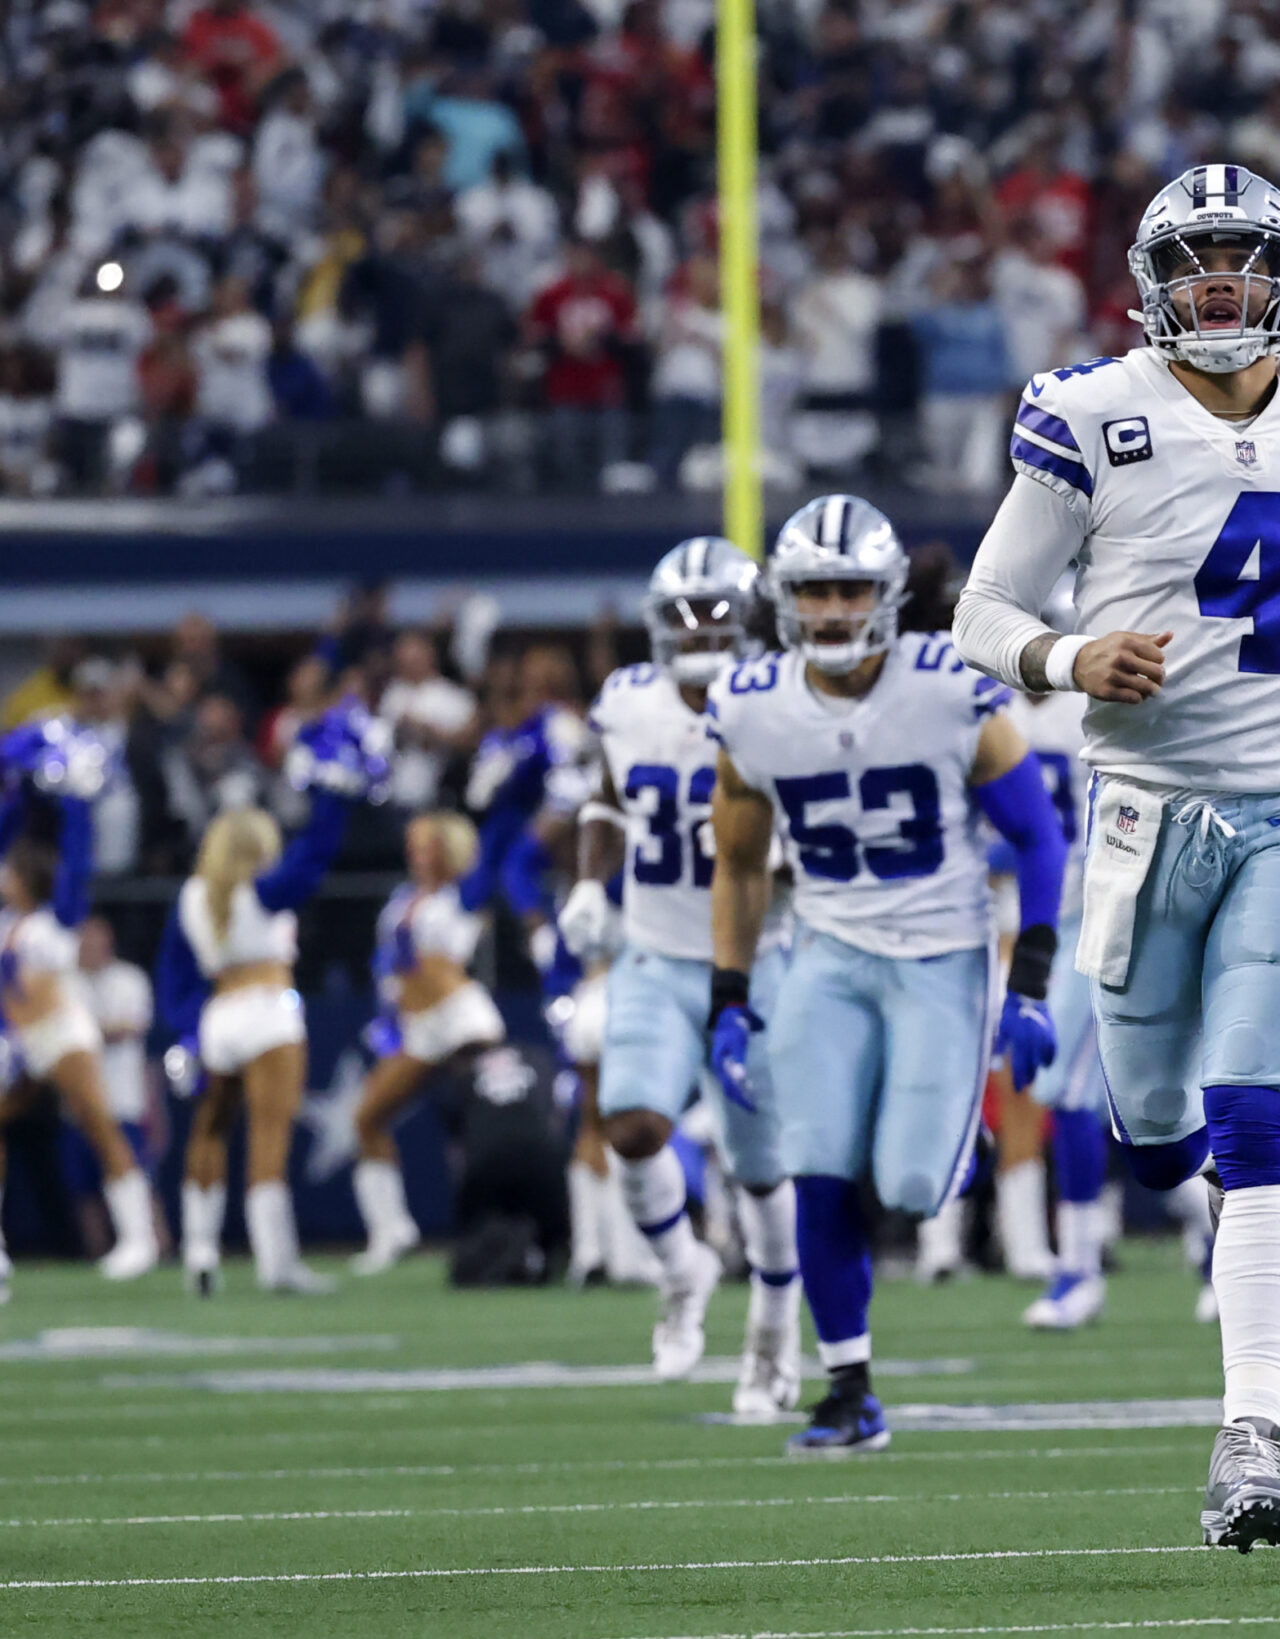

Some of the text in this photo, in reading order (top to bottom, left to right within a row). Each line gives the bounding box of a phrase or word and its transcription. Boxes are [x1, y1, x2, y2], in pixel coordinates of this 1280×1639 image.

[1107, 420, 1148, 453] C
[774, 764, 946, 882] 53
[1106, 834, 1138, 856] Wilson
